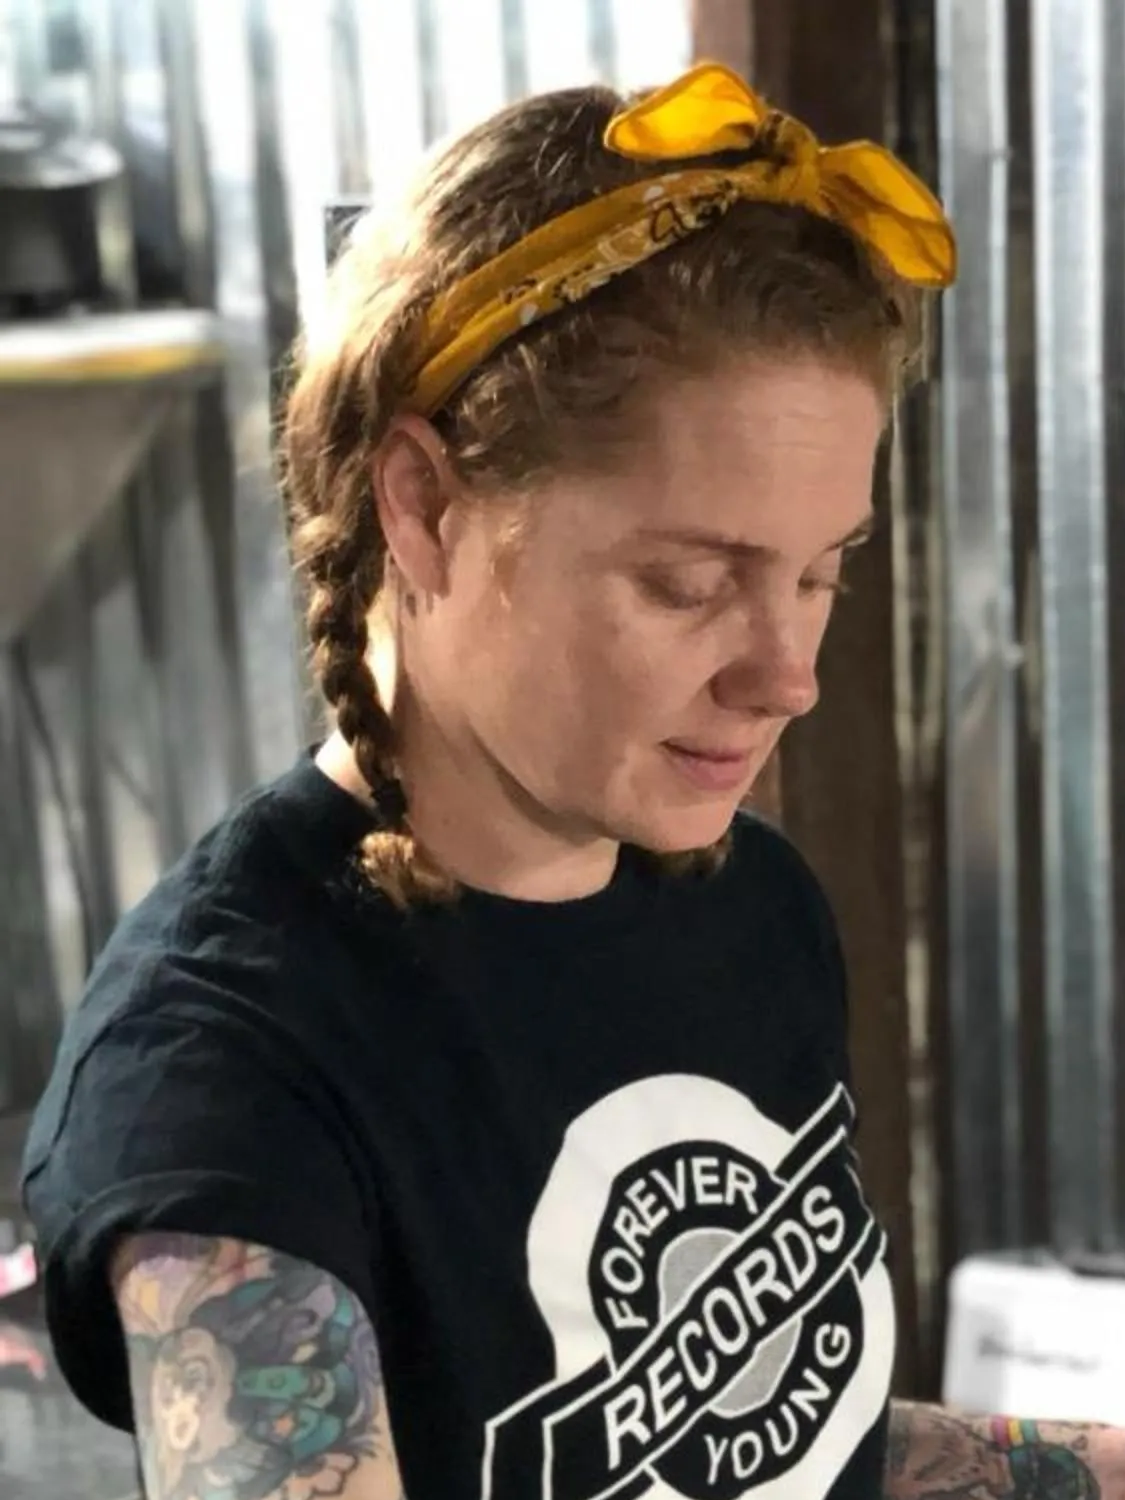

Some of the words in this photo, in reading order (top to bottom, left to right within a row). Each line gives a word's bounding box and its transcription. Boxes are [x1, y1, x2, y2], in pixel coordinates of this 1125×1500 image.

[601, 1156, 759, 1329] FOREVER
[603, 1184, 846, 1471] RECORDS
[704, 1322, 851, 1485] YOUNG
